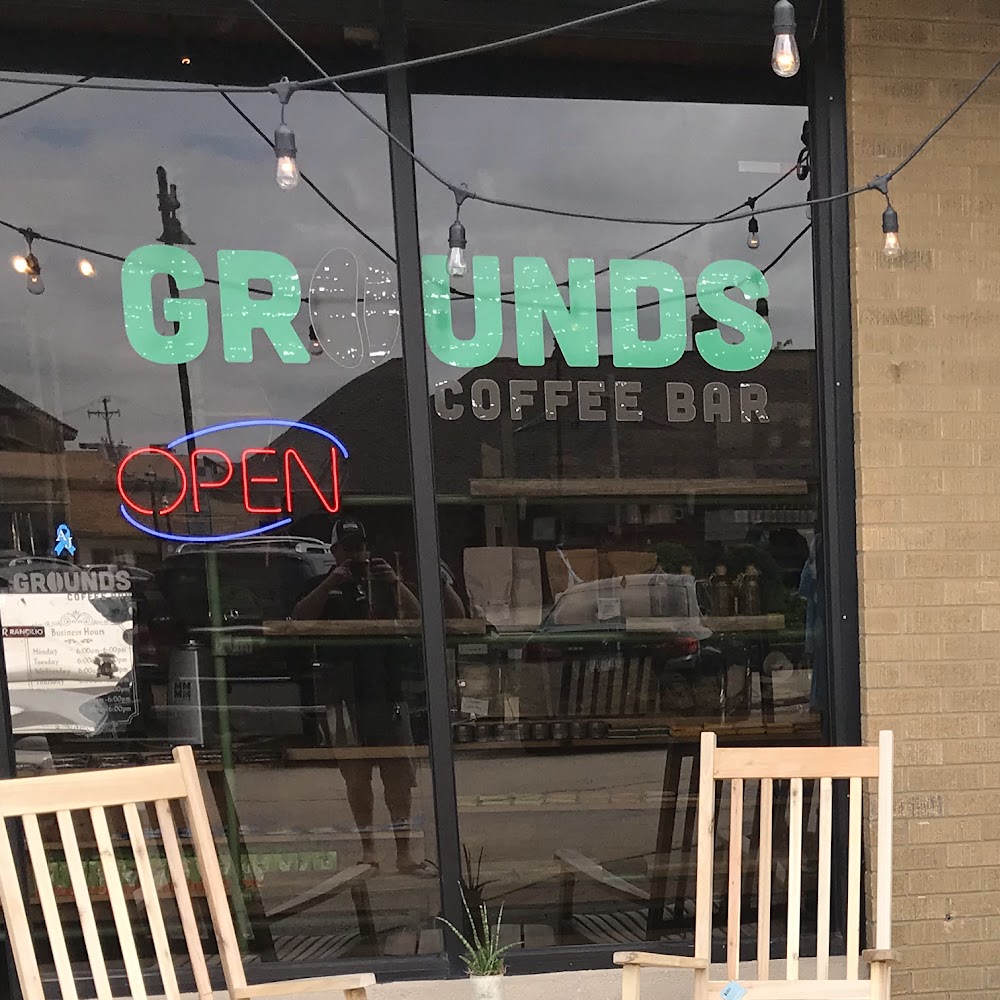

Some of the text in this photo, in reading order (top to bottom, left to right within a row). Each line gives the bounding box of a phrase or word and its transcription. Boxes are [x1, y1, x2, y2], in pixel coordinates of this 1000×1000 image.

[434, 378, 771, 423] COFFEE BAR
[116, 446, 342, 516] OPEN
[51, 627, 105, 637] Business Hours
